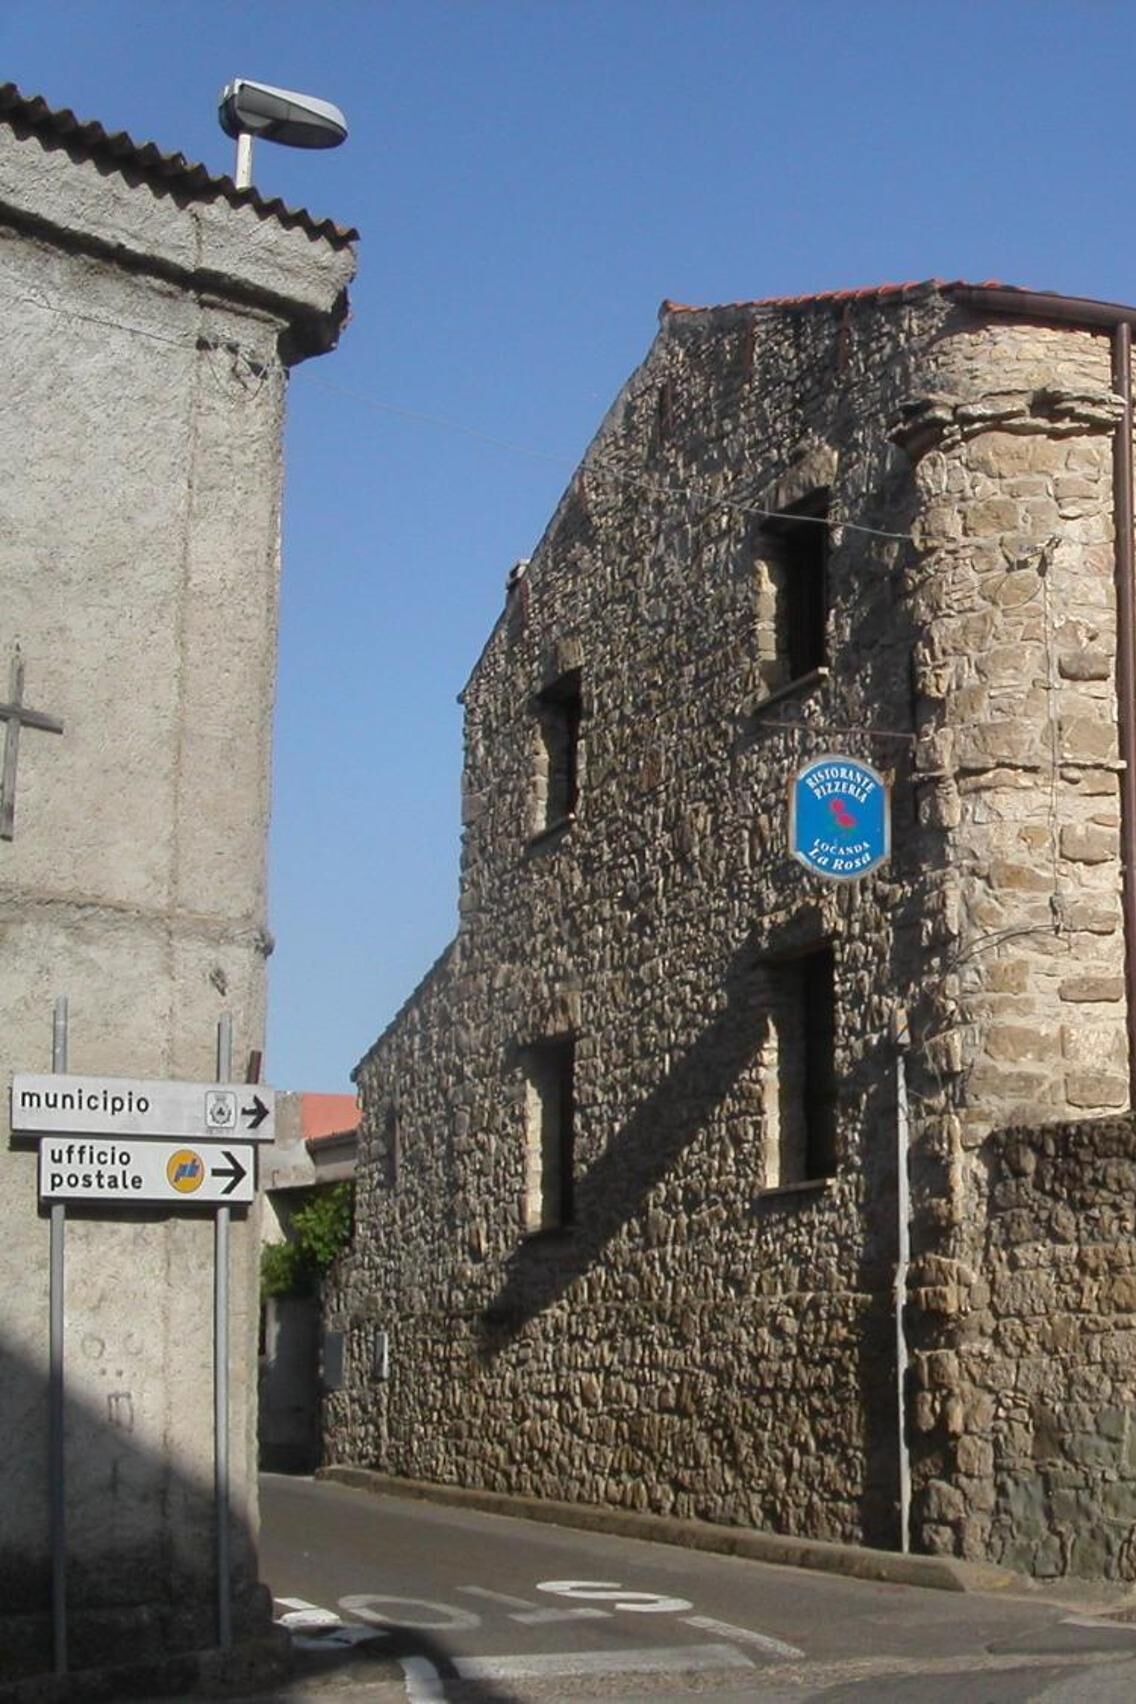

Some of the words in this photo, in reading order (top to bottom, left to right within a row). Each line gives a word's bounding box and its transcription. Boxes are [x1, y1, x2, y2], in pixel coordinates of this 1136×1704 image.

[805, 767, 876, 794] RISTORANTE
[813, 780, 868, 804] PIZZERIA
[808, 847, 830, 866] La
[832, 852, 872, 871] Rosa
[813, 838, 871, 856] LOCANDA
[20, 1087, 150, 1116] municipio
[50, 1144, 132, 1166] ufficio
[50, 1169, 143, 1191] postale
